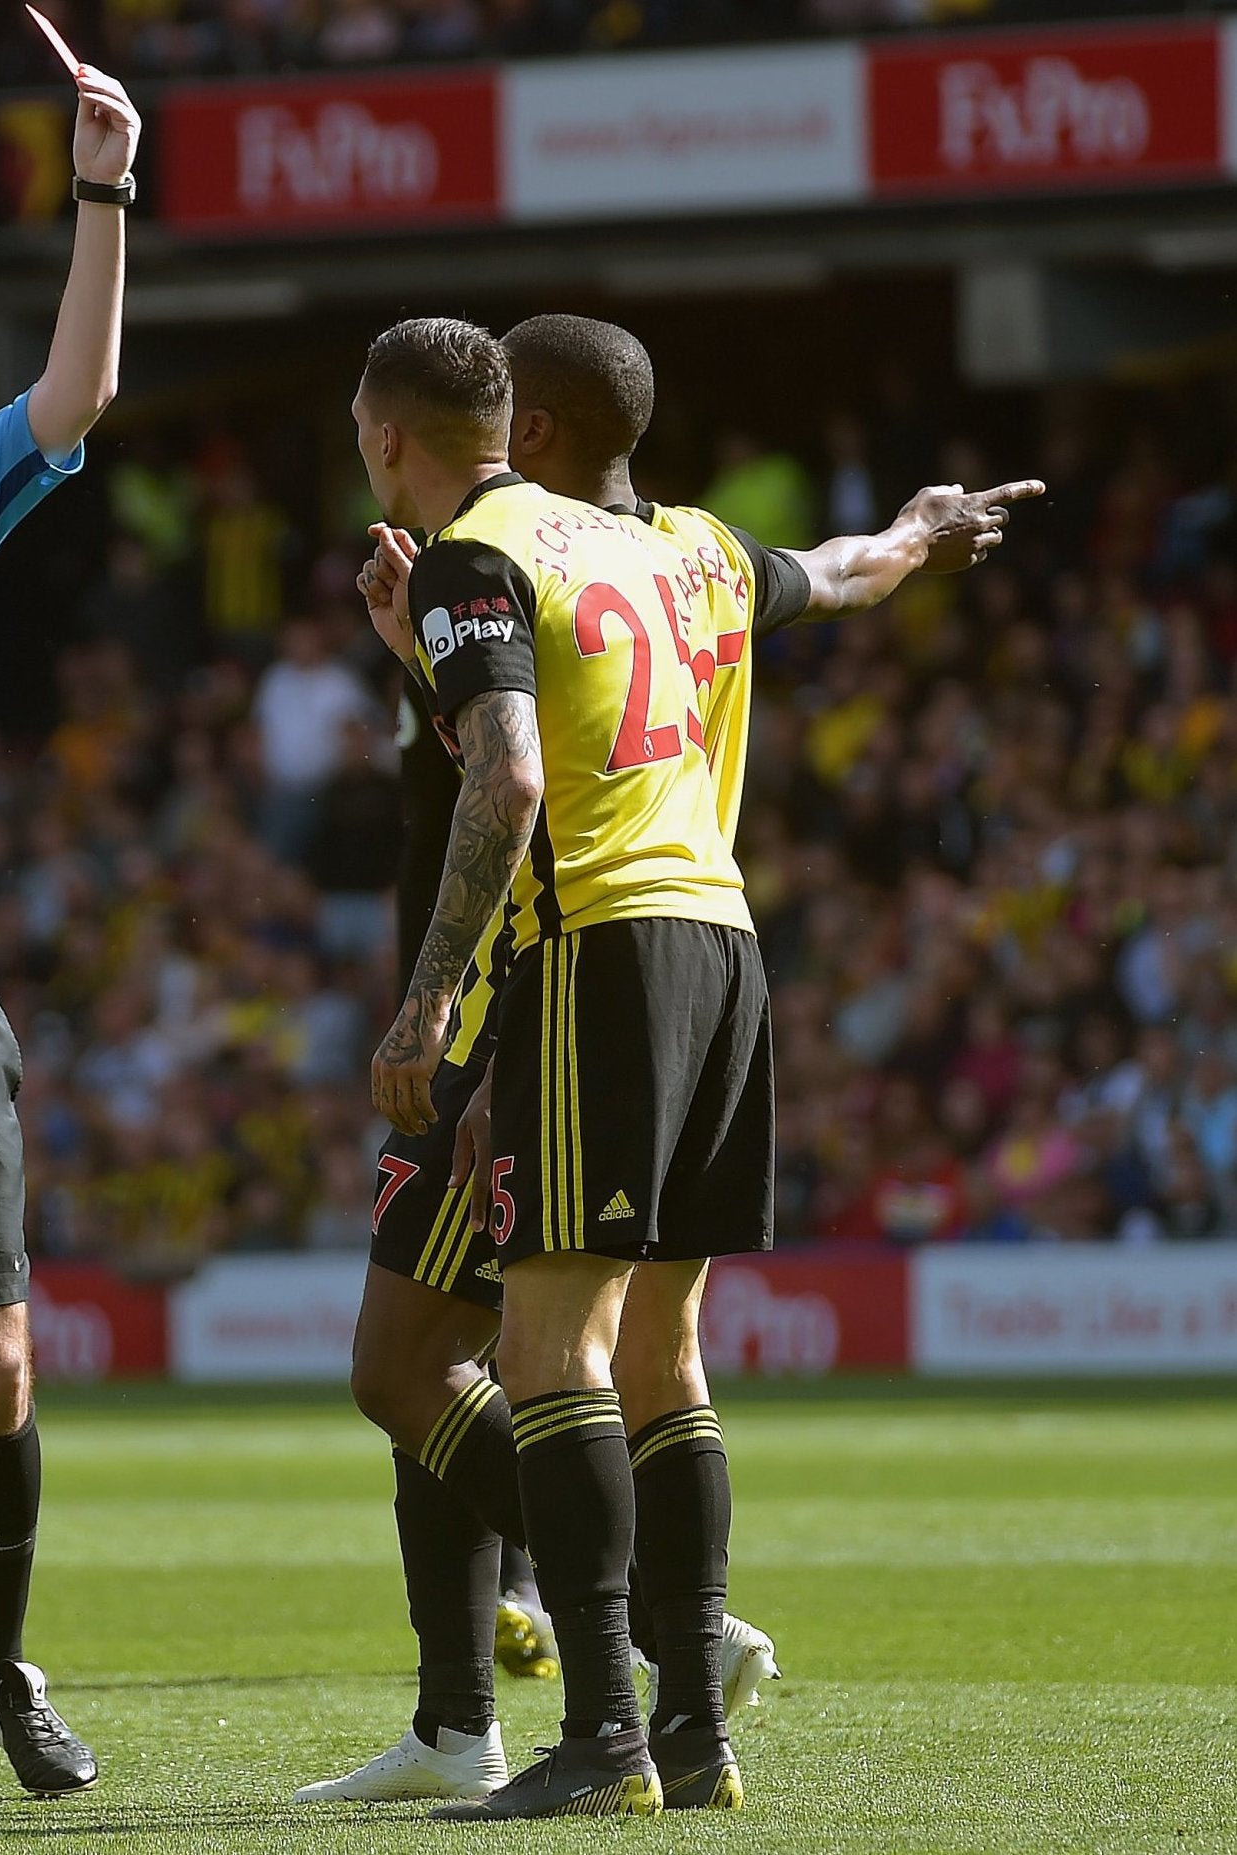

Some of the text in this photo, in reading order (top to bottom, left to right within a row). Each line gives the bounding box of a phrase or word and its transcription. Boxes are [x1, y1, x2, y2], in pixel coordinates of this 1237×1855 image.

[372, 1153, 420, 1236] 7
[493, 1156, 515, 1245] 5
[598, 1207, 636, 1221] adidas
